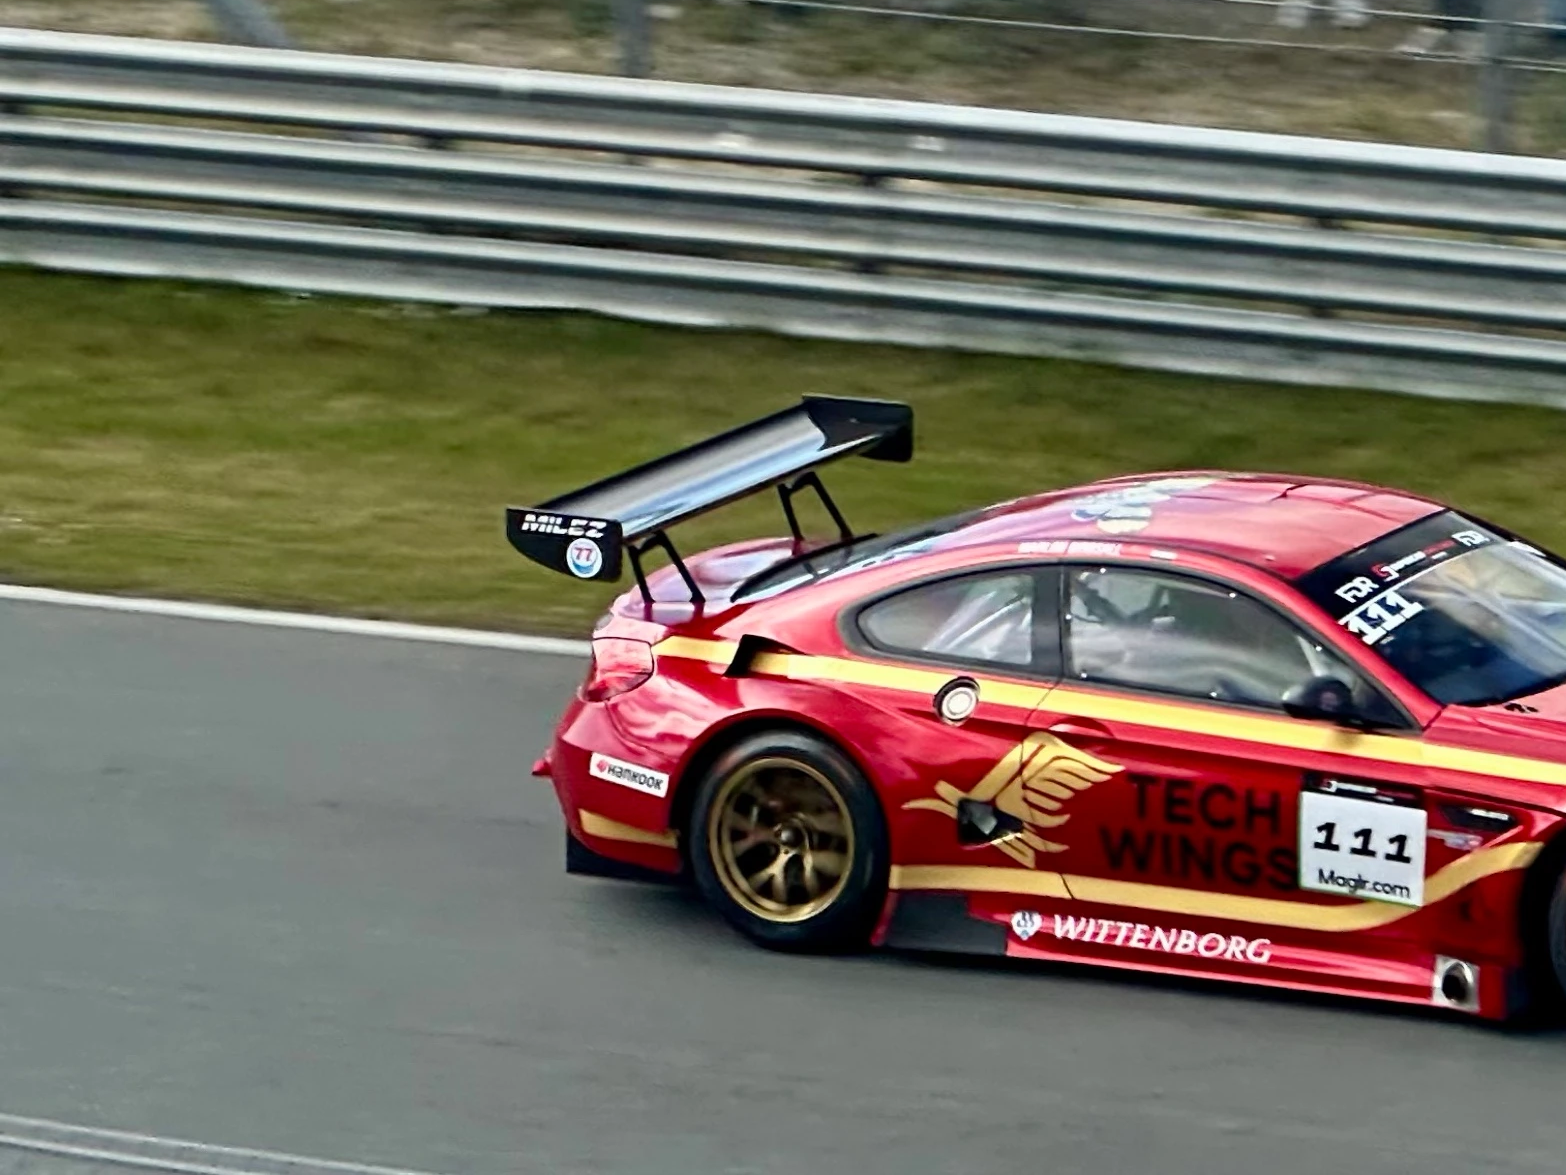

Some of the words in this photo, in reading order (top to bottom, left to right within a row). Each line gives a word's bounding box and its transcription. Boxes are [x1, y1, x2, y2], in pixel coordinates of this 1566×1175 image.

[521, 514, 607, 538] MILEZ
[1127, 772, 1282, 836] TECH
[1100, 826, 1299, 892] WINGS
[1313, 822, 1412, 864] 111
[1053, 913, 1272, 964] WITTENBORG
